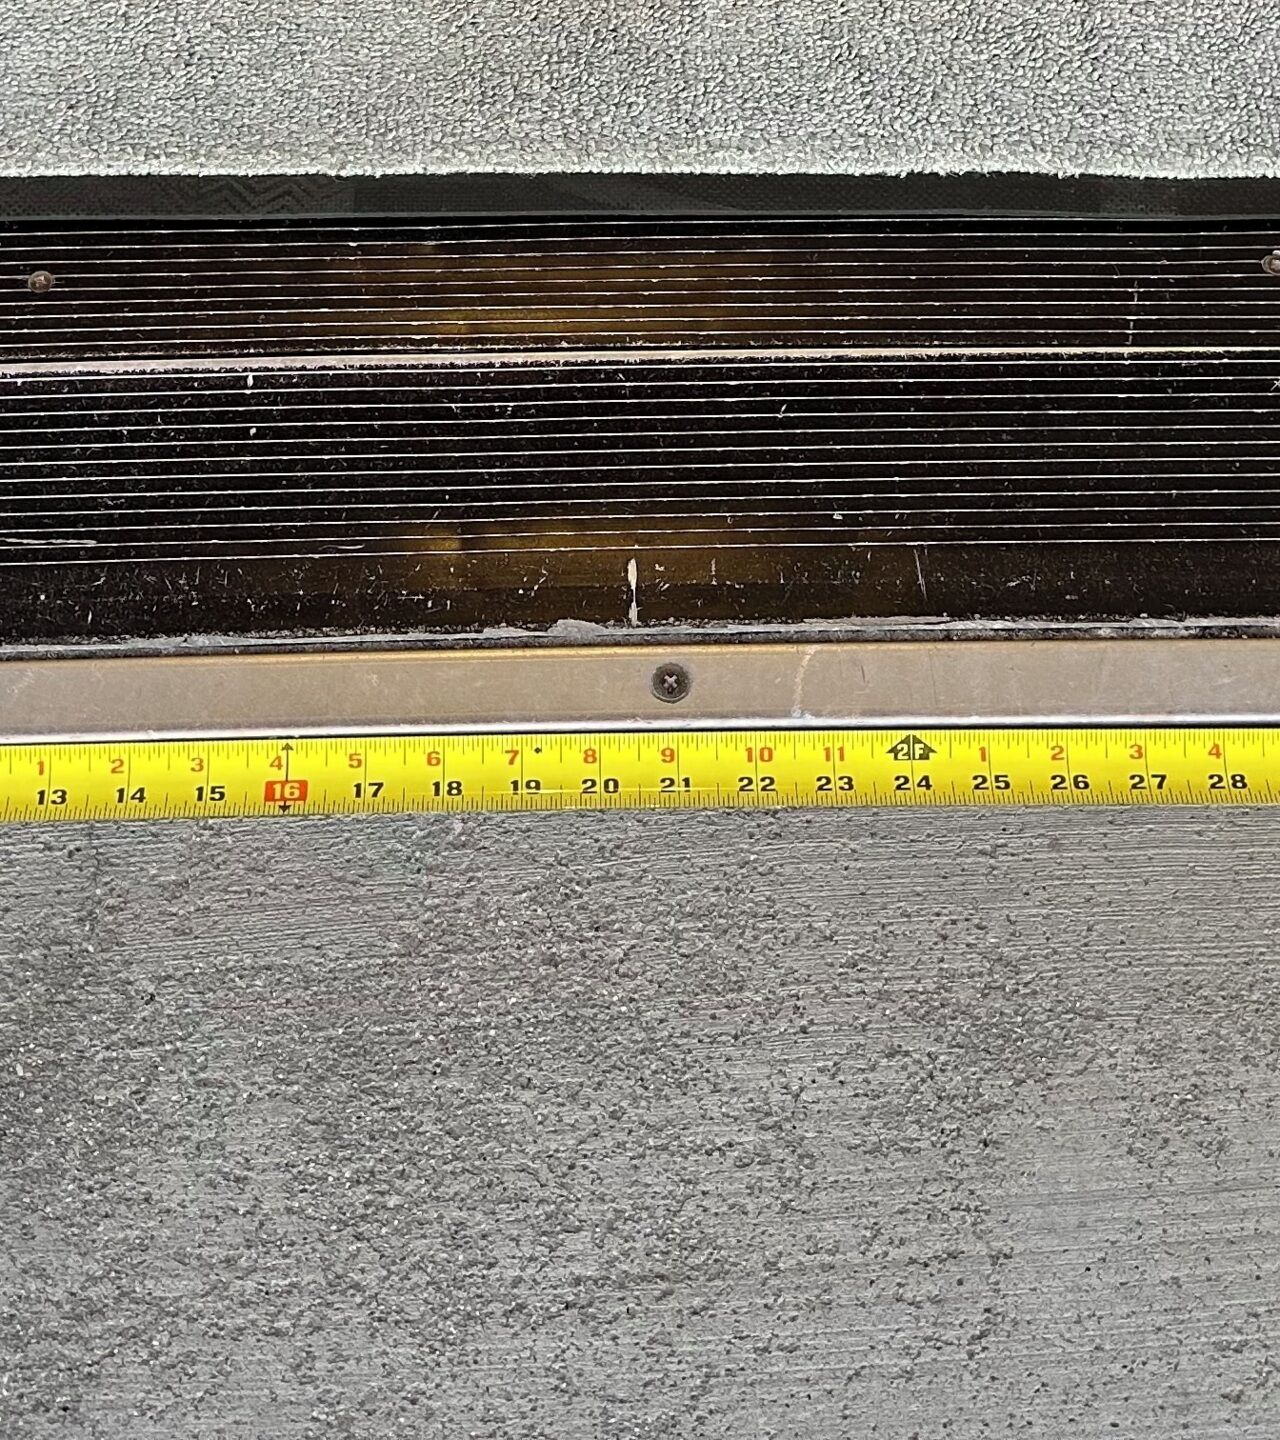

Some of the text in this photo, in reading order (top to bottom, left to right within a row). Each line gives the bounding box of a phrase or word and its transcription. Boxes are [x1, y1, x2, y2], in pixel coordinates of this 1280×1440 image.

[36, 760, 44, 776] 1
[110, 758, 124, 774] 2
[190, 757, 204, 772] 3
[269, 755, 283, 771] 4
[348, 753, 363, 769] 5
[426, 751, 441, 767] 6
[504, 749, 519, 765] 7
[583, 748, 597, 764] 8
[660, 747, 675, 763] 9
[745, 746, 773, 762] 10
[823, 746, 845, 762] 11
[897, 744, 925, 760] 2F
[978, 746, 987, 762] 1
[1050, 745, 1065, 761] 2
[1129, 744, 1144, 760] 3
[1208, 743, 1223, 759] 4
[36, 789, 67, 805] 13
[116, 787, 146, 803] 14
[195, 786, 226, 802] 15
[271, 782, 300, 799] 16
[353, 782, 384, 798] 17
[432, 781, 463, 797] 18
[510, 779, 542, 795] 19
[581, 778, 619, 794] 20
[660, 777, 691, 792] 21
[738, 776, 776, 792] 22
[816, 776, 854, 791] 23
[894, 775, 933, 791] 24
[972, 775, 1011, 790] 25
[1051, 774, 1090, 790] 26
[1128, 774, 1167, 790] 27
[1208, 774, 1248, 789] 28
